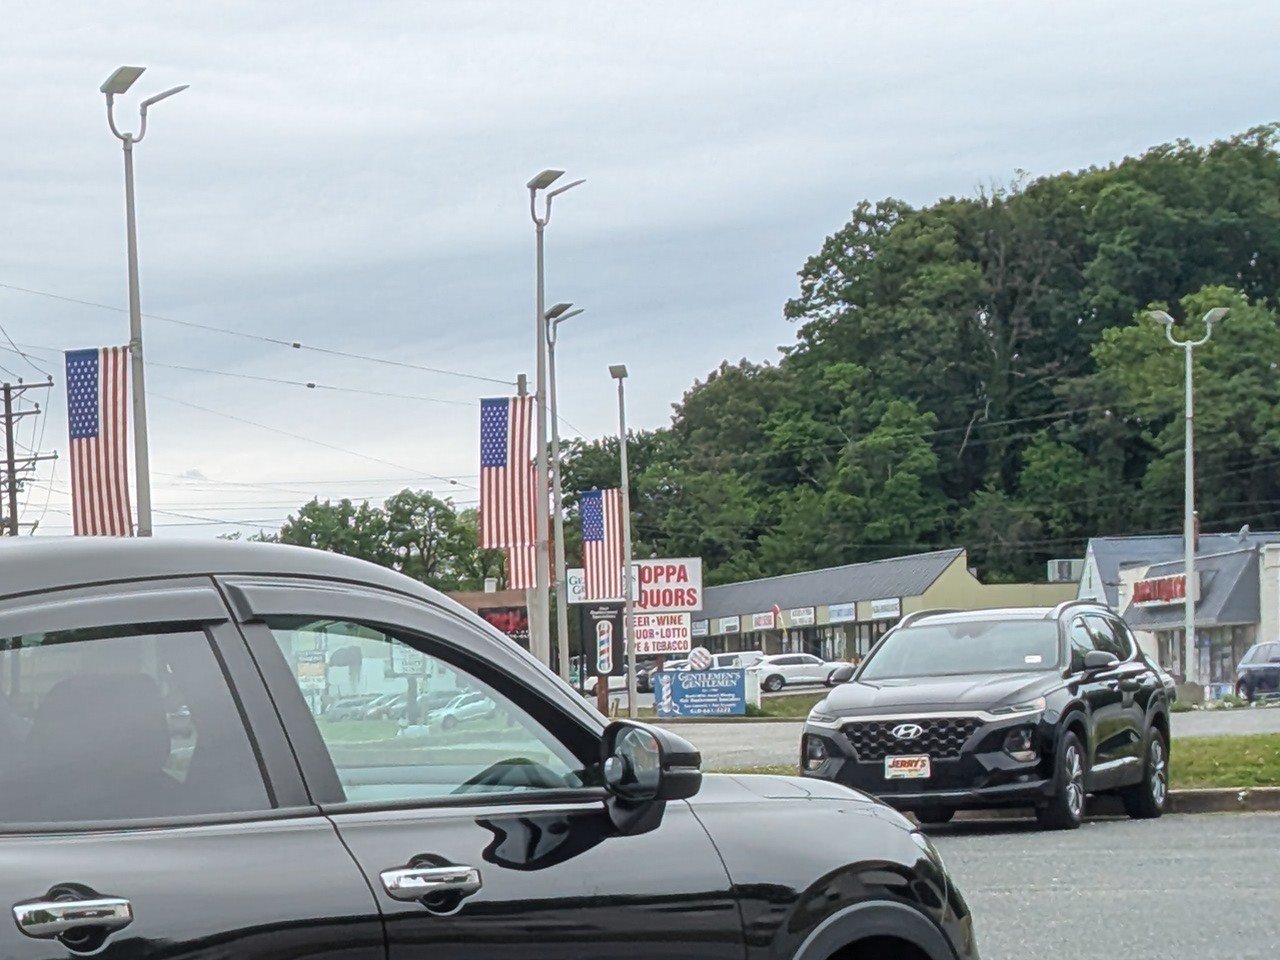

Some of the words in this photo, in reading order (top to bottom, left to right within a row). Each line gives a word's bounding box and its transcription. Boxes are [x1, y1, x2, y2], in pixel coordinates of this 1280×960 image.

[640, 564, 689, 584] OPPA
[637, 588, 698, 609] QUORS
[656, 615, 684, 626] WINE
[660, 627, 688, 639] LOTTO
[644, 641, 650, 652] &
[888, 759, 927, 769] JERRY'S
